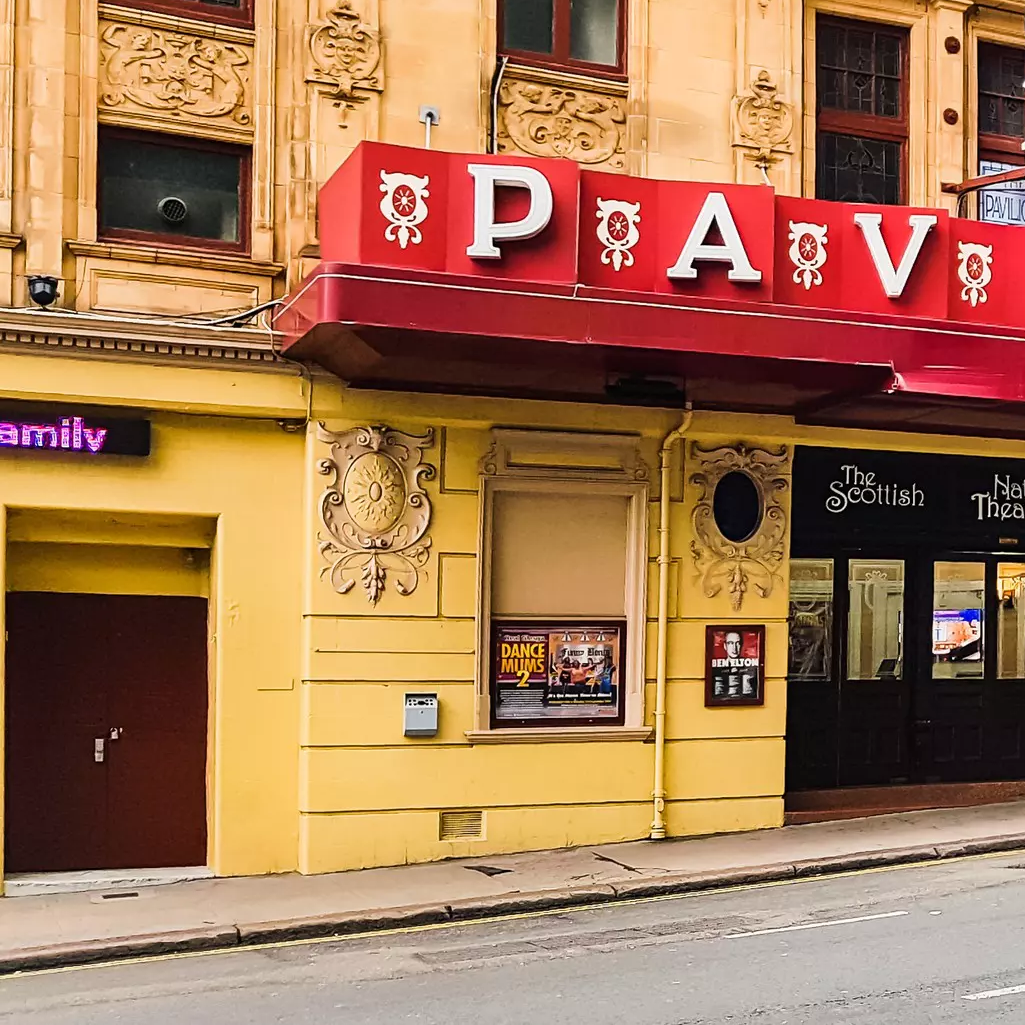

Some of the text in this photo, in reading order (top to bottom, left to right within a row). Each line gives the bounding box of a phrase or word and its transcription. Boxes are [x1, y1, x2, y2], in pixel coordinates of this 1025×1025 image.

[841, 464, 877, 487] The
[826, 480, 925, 513] Scottish
[501, 642, 545, 659] DANCE
[500, 658, 545, 673] MUMS
[711, 658, 759, 667] BEN ELTON
[516, 670, 530, 688] 2
